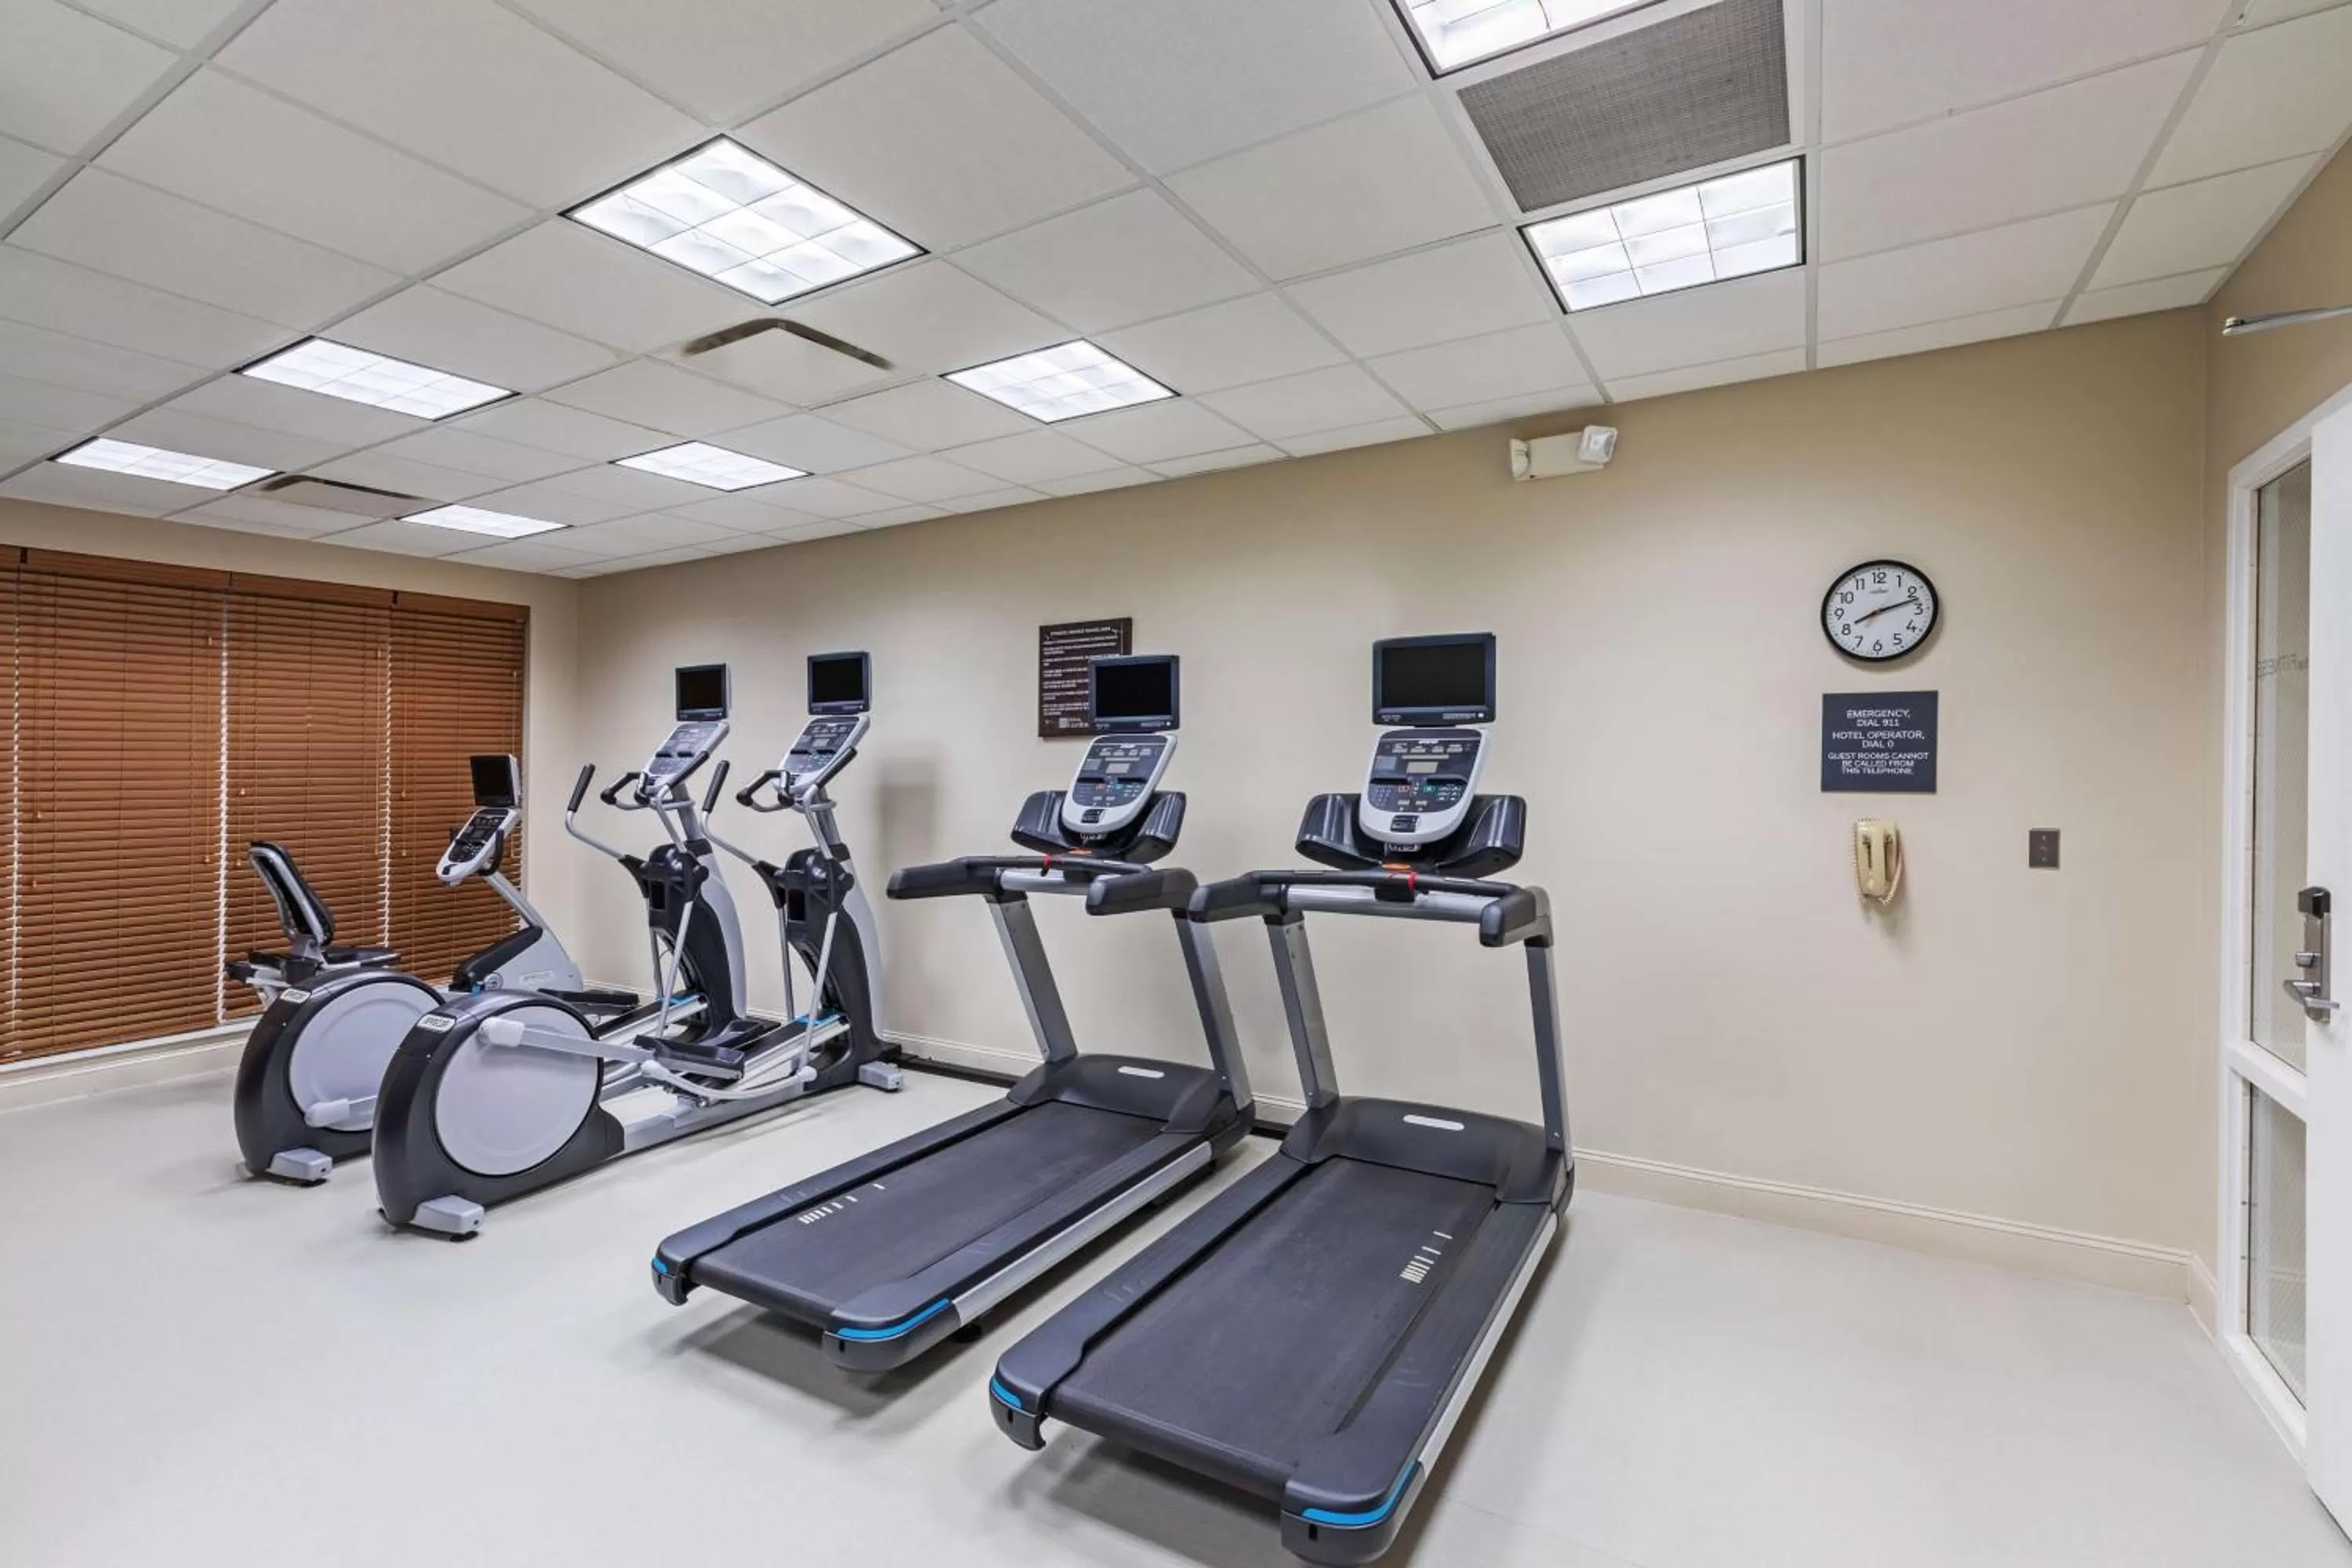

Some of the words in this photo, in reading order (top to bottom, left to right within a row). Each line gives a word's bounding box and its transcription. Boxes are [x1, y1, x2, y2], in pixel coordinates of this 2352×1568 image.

[1871, 572, 1887, 583] 12
[1896, 575, 1901, 587] 1
[1856, 578, 1865, 590] 11
[1836, 591, 1854, 604] 10
[1907, 586, 1917, 598] 2
[1834, 608, 1845, 620] 9
[1914, 602, 1923, 615] 3
[1842, 624, 1851, 635] 8
[1906, 619, 1917, 633] 4
[1855, 636, 1864, 648] 7
[1893, 633, 1903, 646] 5
[1873, 640, 1882, 652] 6
[1832, 731, 1864, 739] HOTEL
